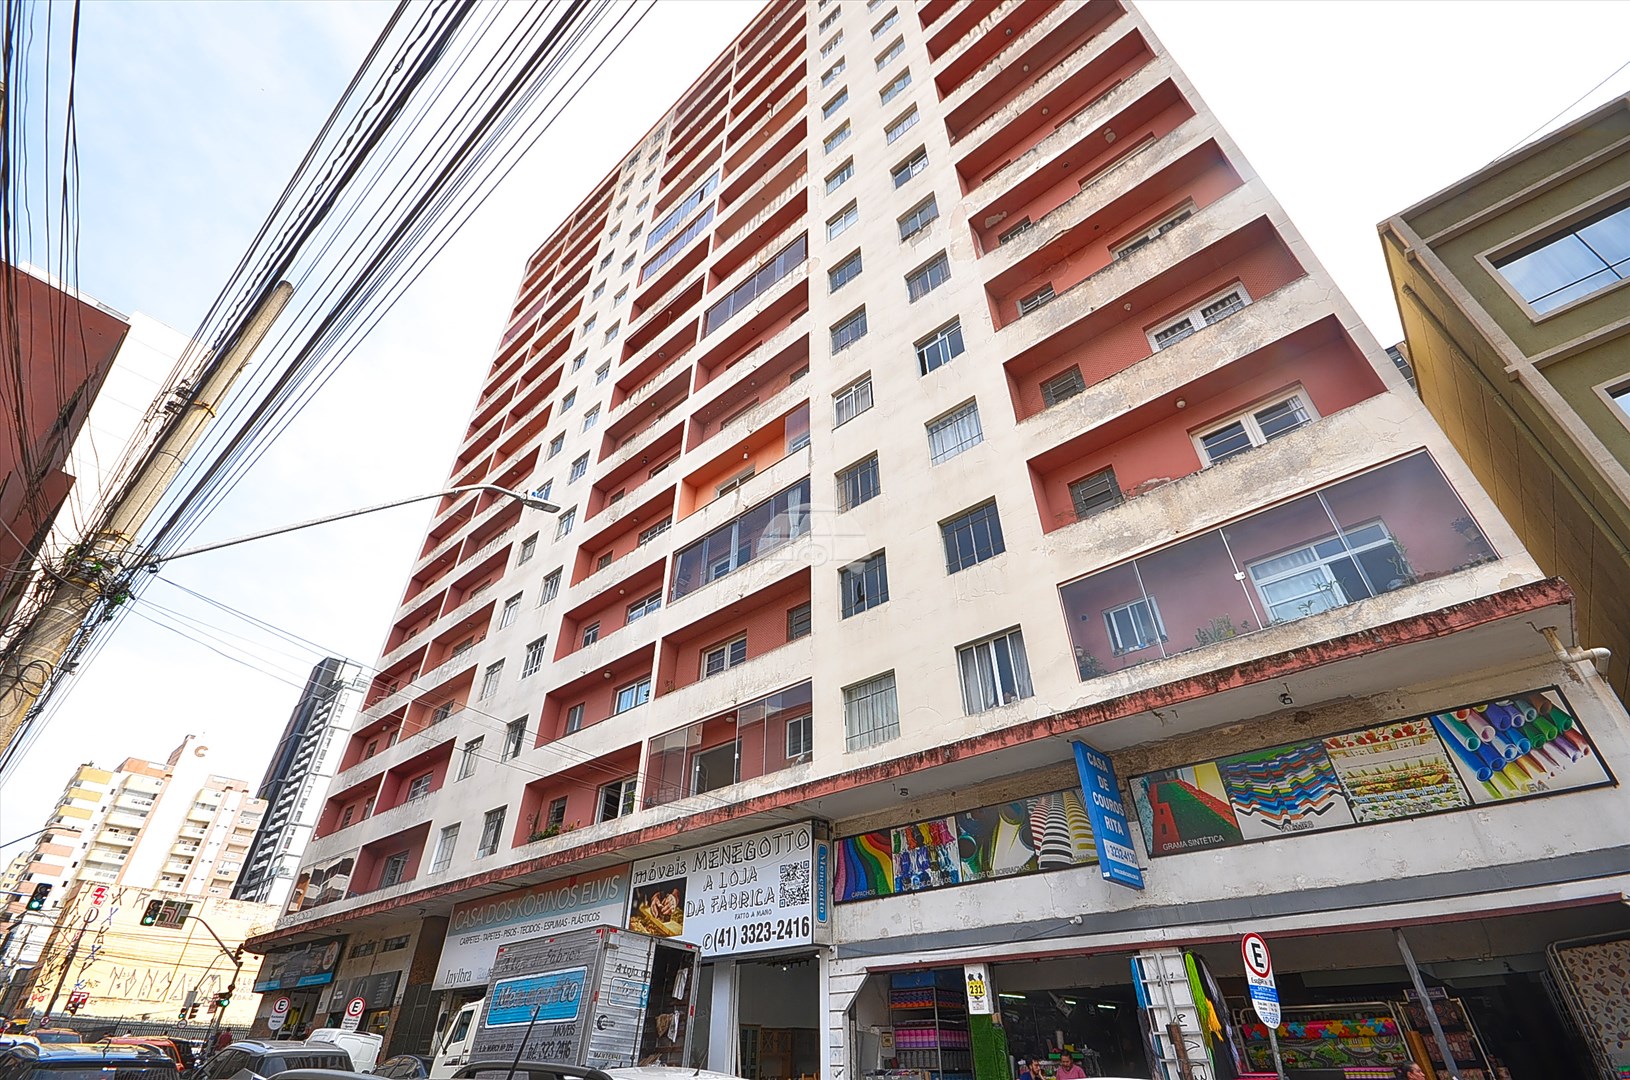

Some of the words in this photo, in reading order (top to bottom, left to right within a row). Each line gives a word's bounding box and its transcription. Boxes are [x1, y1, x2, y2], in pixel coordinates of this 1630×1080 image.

[1086, 752, 1109, 774] CASA
[1097, 774, 1110, 792] DE
[1529, 780, 1550, 794] EVA
[1092, 791, 1125, 817] COUROS
[1104, 815, 1124, 836] RITA
[1163, 839, 1188, 851] GRAMA
[1188, 834, 1225, 848] SINTÉTICA
[633, 855, 687, 885] móveis
[692, 828, 810, 873] MENEGOTTO
[703, 875, 714, 892] A
[720, 866, 758, 888] LOJA
[454, 906, 488, 931] CASA
[486, 899, 515, 926] DOS
[516, 884, 579, 918] KORINOS
[580, 874, 620, 906] ELVIS
[686, 898, 706, 918] DA
[710, 886, 776, 914] FÁBRICA
[851, 888, 876, 898] CAPACHOS
[460, 934, 480, 946] CARPETES
[482, 930, 501, 942] TAPETES
[504, 927, 517, 938] PISOS
[520, 922, 541, 935] TECIDOS
[544, 917, 568, 930] ESPUMAS
[570, 911, 601, 926] PLÁSTICOS
[713, 926, 737, 952] (41)
[740, 916, 810, 946] 3323-2416
[1250, 942, 1264, 969] E
[970, 984, 984, 994] 231
[278, 1000, 286, 1010] E
[352, 1002, 360, 1012] E
